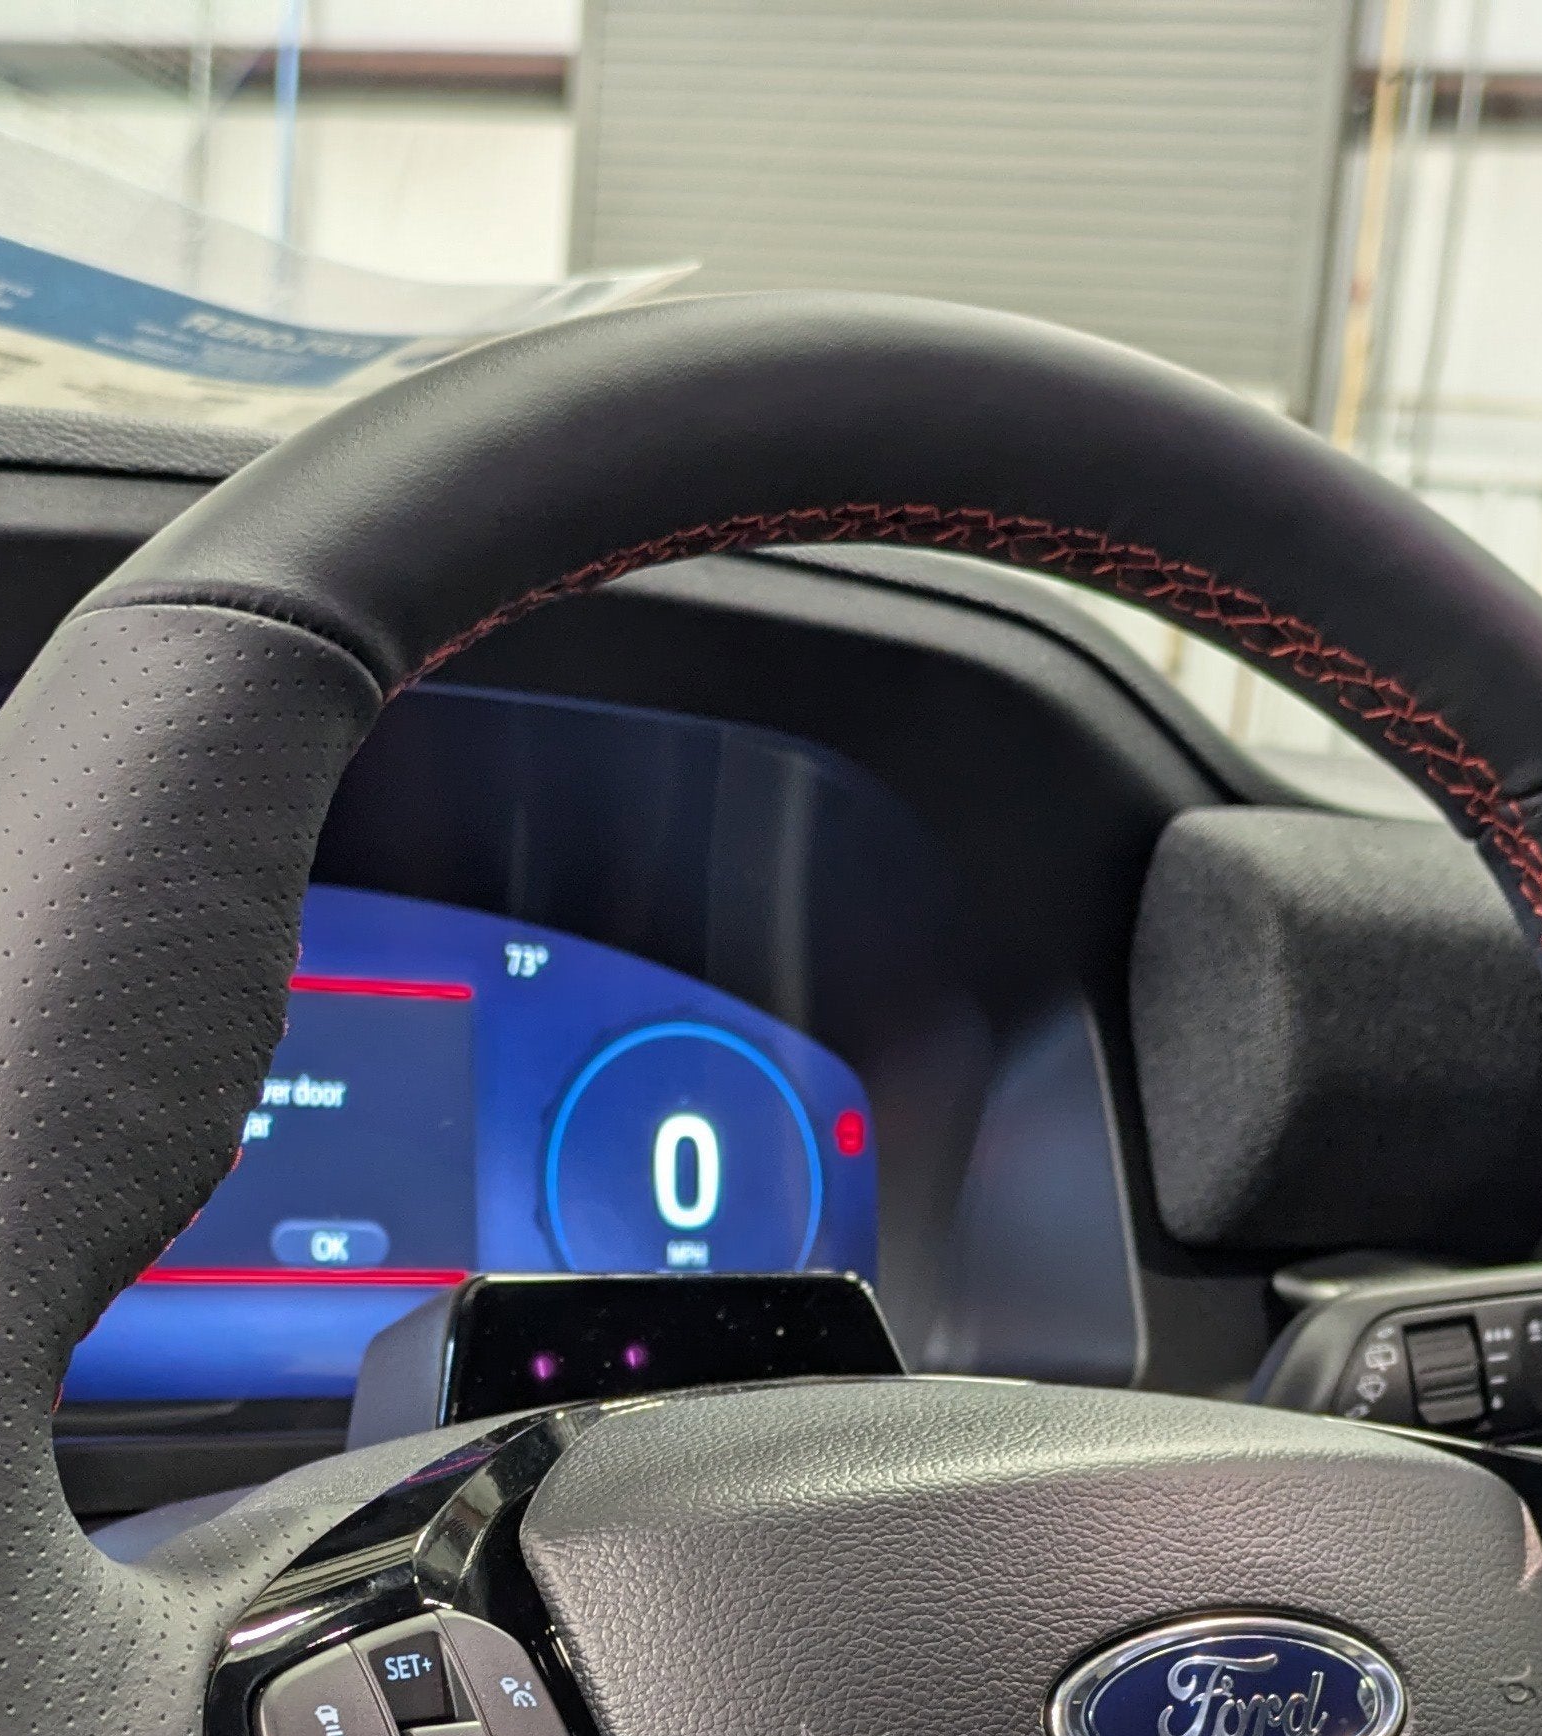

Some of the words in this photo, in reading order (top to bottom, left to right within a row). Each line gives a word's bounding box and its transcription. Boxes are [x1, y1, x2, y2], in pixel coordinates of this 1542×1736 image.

[292, 1073, 347, 1108] door
[653, 1112, 720, 1231] 0
[310, 1231, 350, 1263] OK
[384, 1652, 434, 1682] SET+
